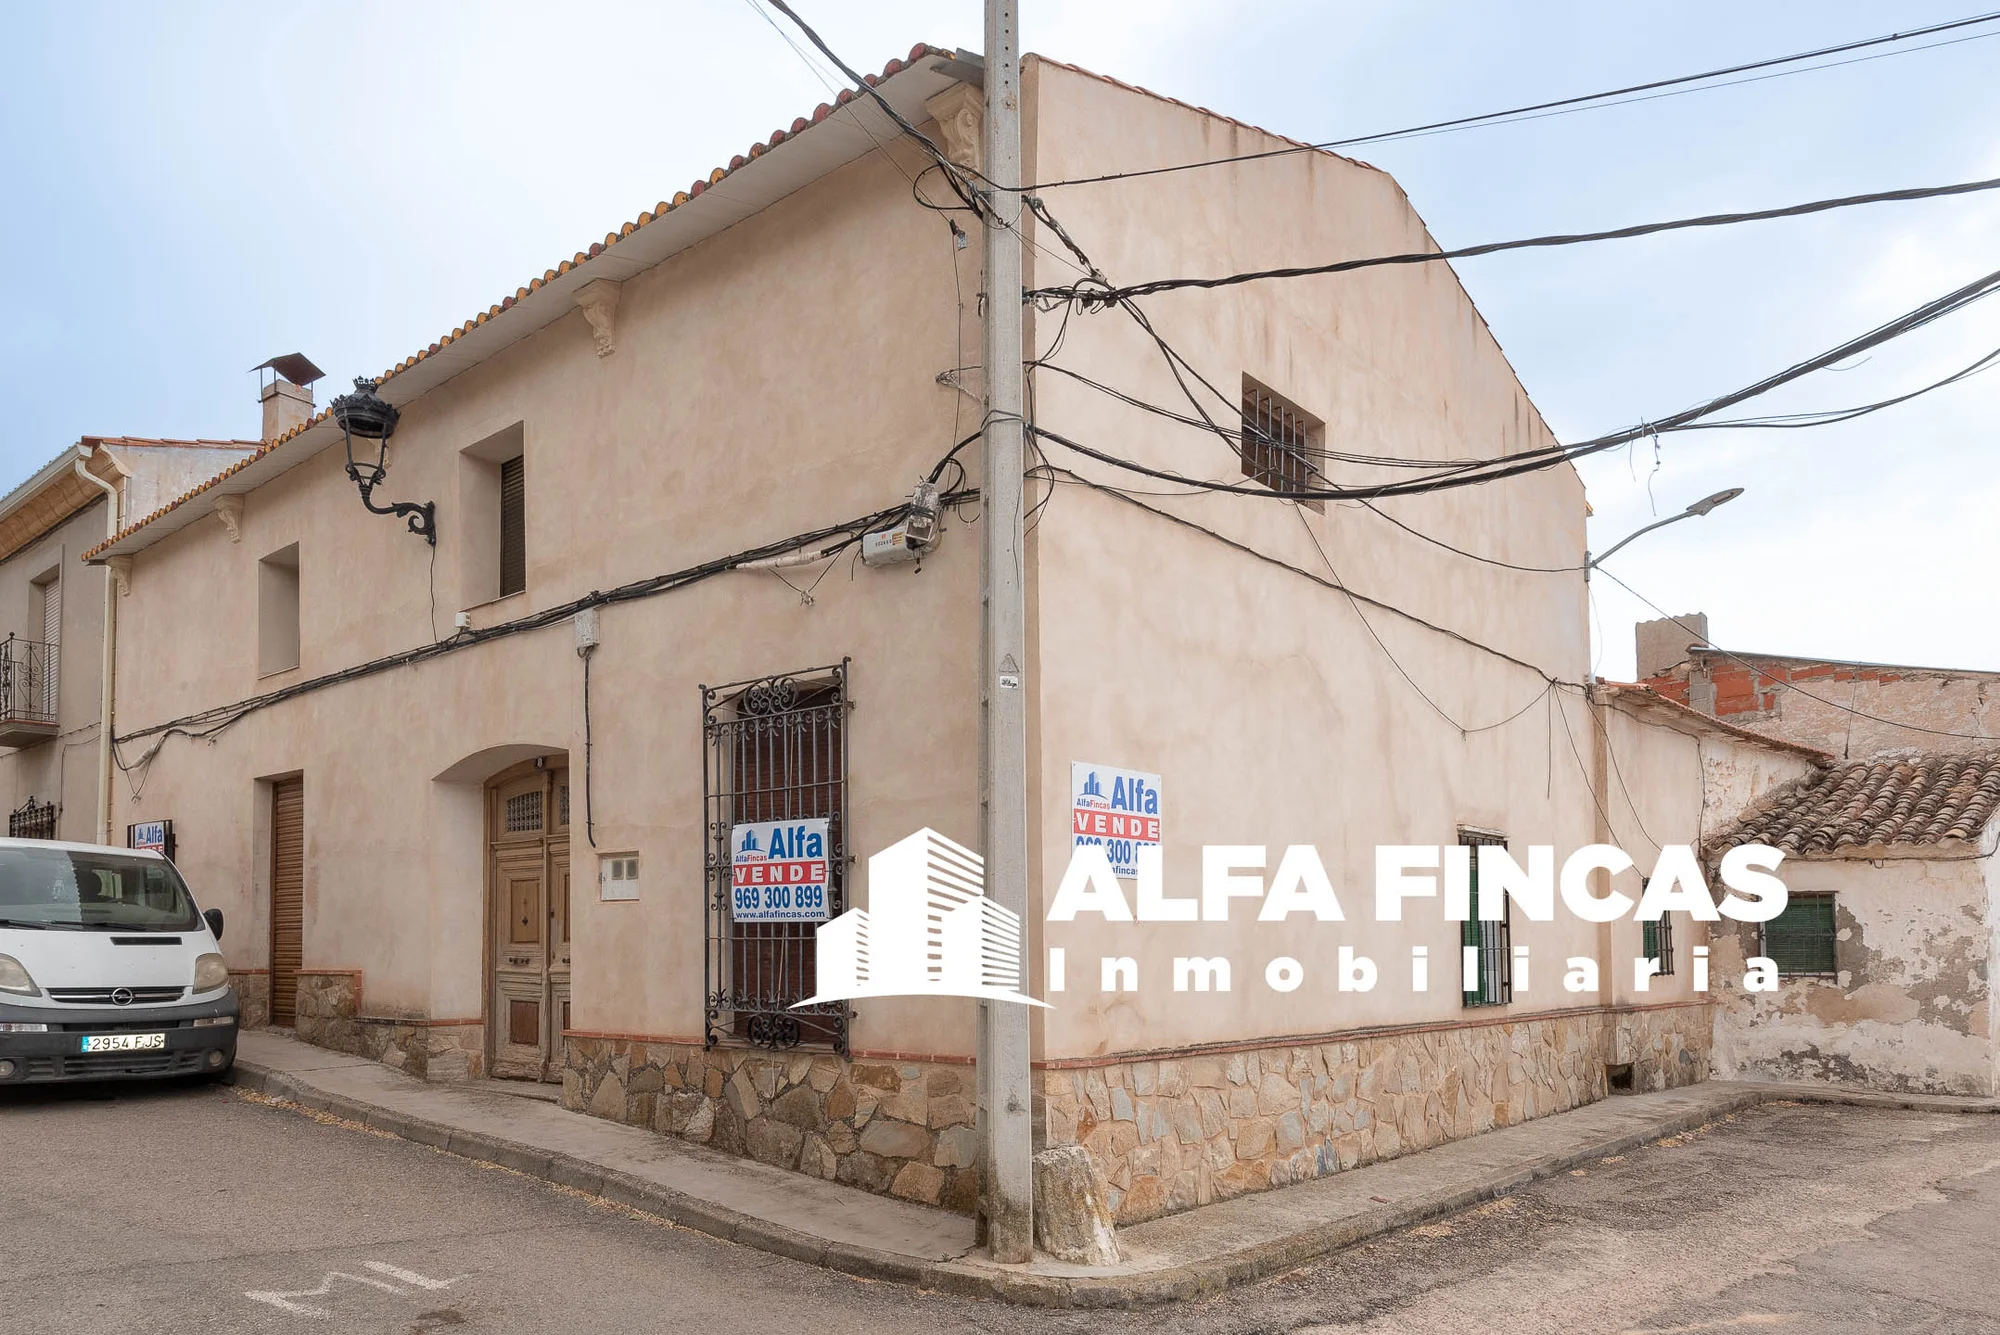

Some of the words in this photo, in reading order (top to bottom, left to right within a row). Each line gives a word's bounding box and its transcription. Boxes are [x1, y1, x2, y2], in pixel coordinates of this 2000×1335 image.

[1076, 798, 1110, 810] AlfaFincas
[1111, 776, 1158, 814] Alfa
[146, 825, 163, 844] Alfa
[1076, 812, 1159, 839] VENDE
[768, 826, 823, 859] Alfa
[1107, 838, 1131, 865] 300
[736, 854, 768, 862] AlfaFincas
[735, 864, 824, 883] VENDE
[735, 887, 760, 909] 969
[764, 886, 791, 908] 300
[795, 885, 823, 908] 899
[736, 910, 825, 919] www.alfafincas.com
[92, 1037, 129, 1050] 2954
[134, 1035, 162, 1048] FJS
